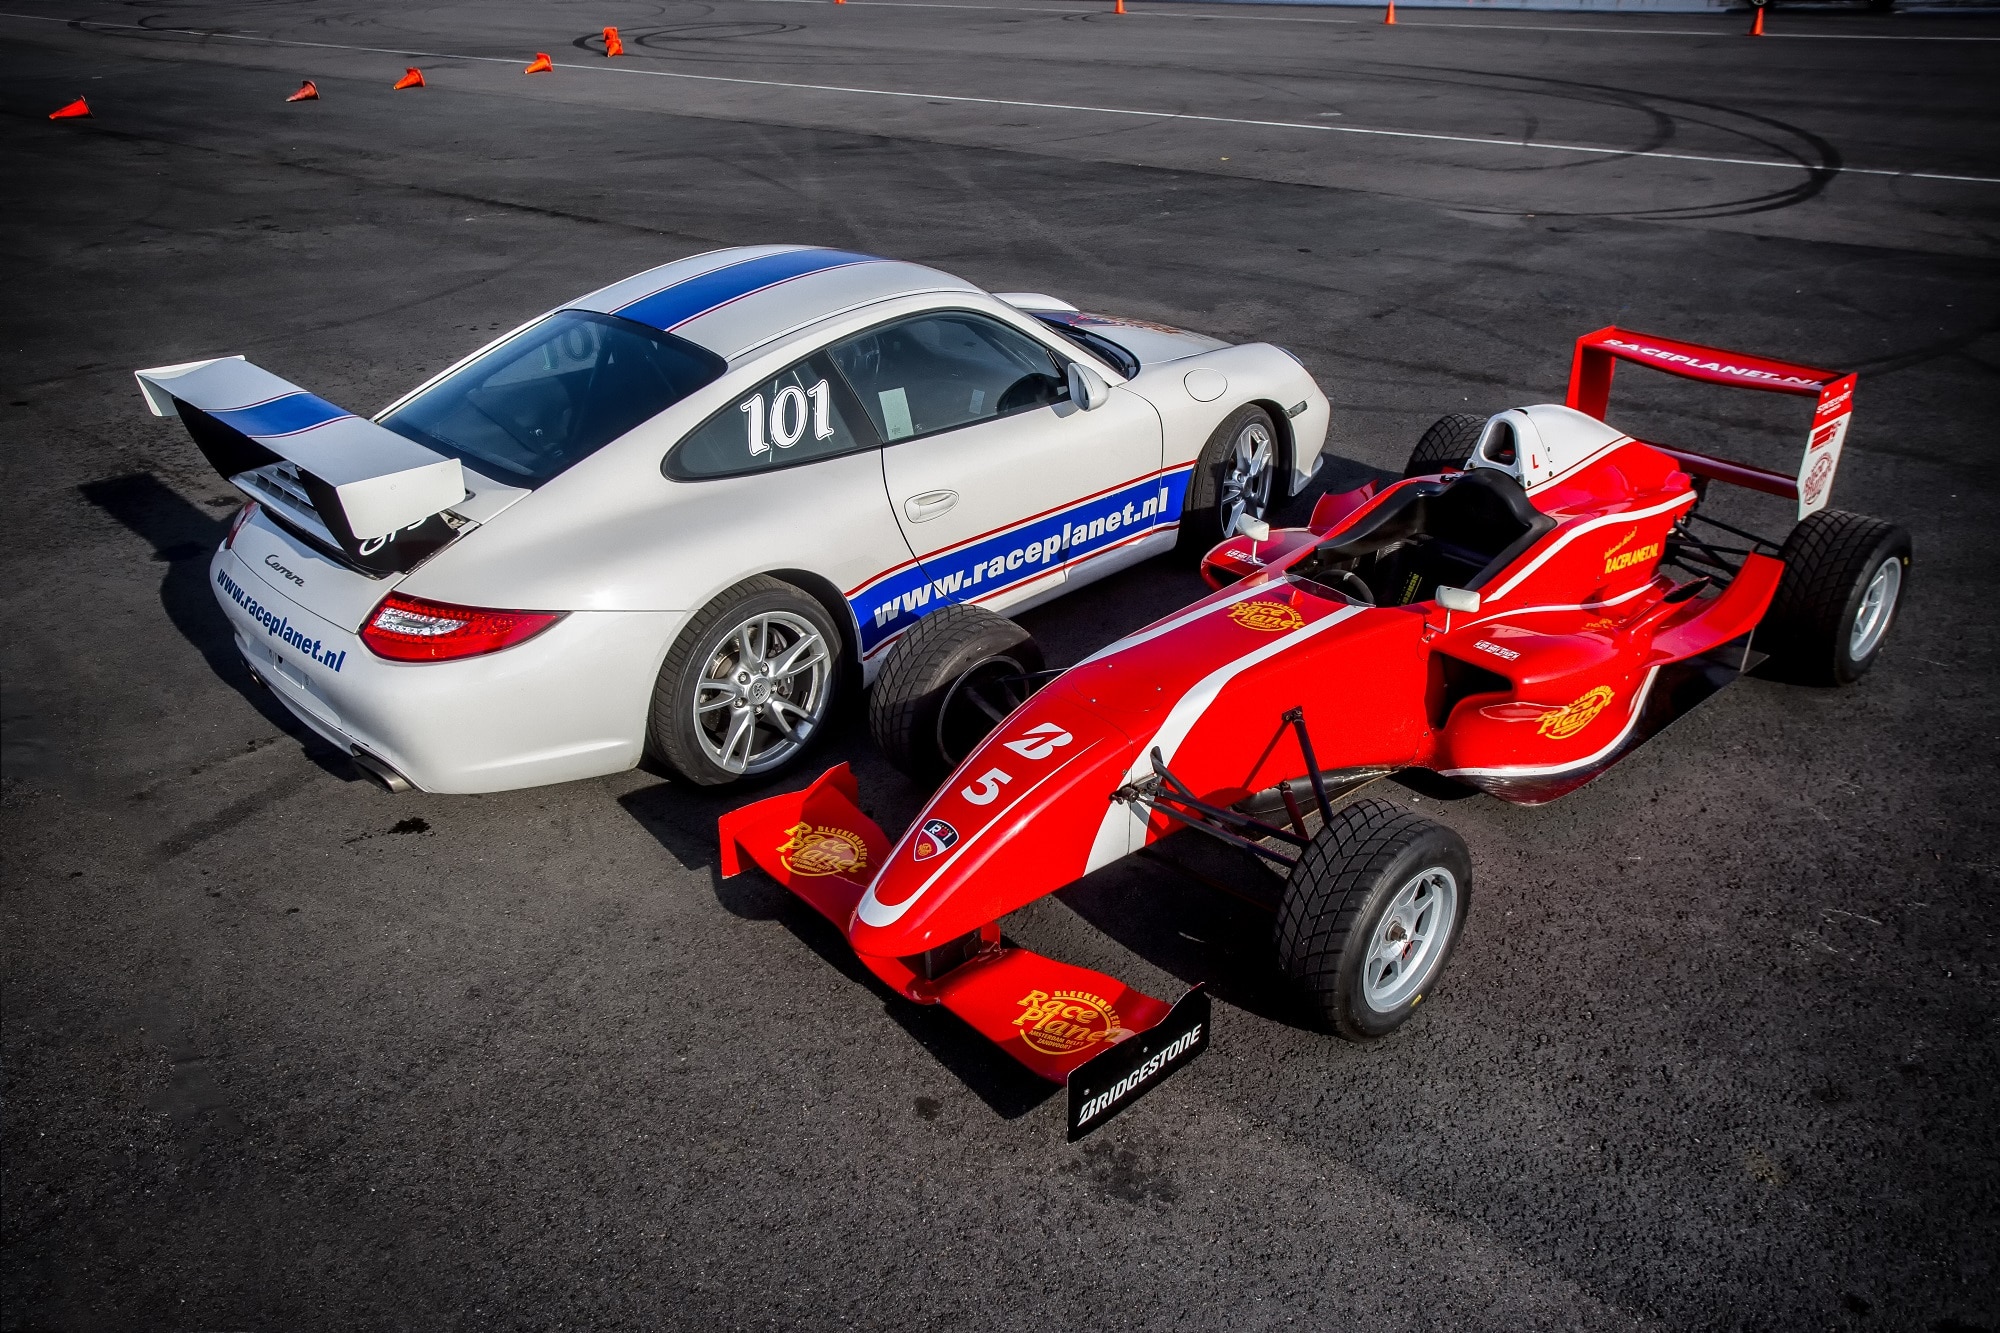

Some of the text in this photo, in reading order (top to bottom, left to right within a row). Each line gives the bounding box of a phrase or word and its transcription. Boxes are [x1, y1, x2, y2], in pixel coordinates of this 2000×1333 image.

[740, 379, 834, 457] 101
[1532, 453, 1539, 470] L
[264, 554, 304, 587] Carrera
[874, 486, 1169, 629] www.raceplanet.nl
[216, 568, 347, 673] www.raceplanet.nl
[961, 767, 1013, 805] 5
[776, 836, 867, 873] Planet
[784, 821, 851, 853] Race
[1012, 1006, 1121, 1043] Planet
[1017, 989, 1099, 1024] Race
[1054, 990, 1121, 1030] BLEEKEMOLENS
[1077, 1023, 1202, 1127] BRIDGESTONE
